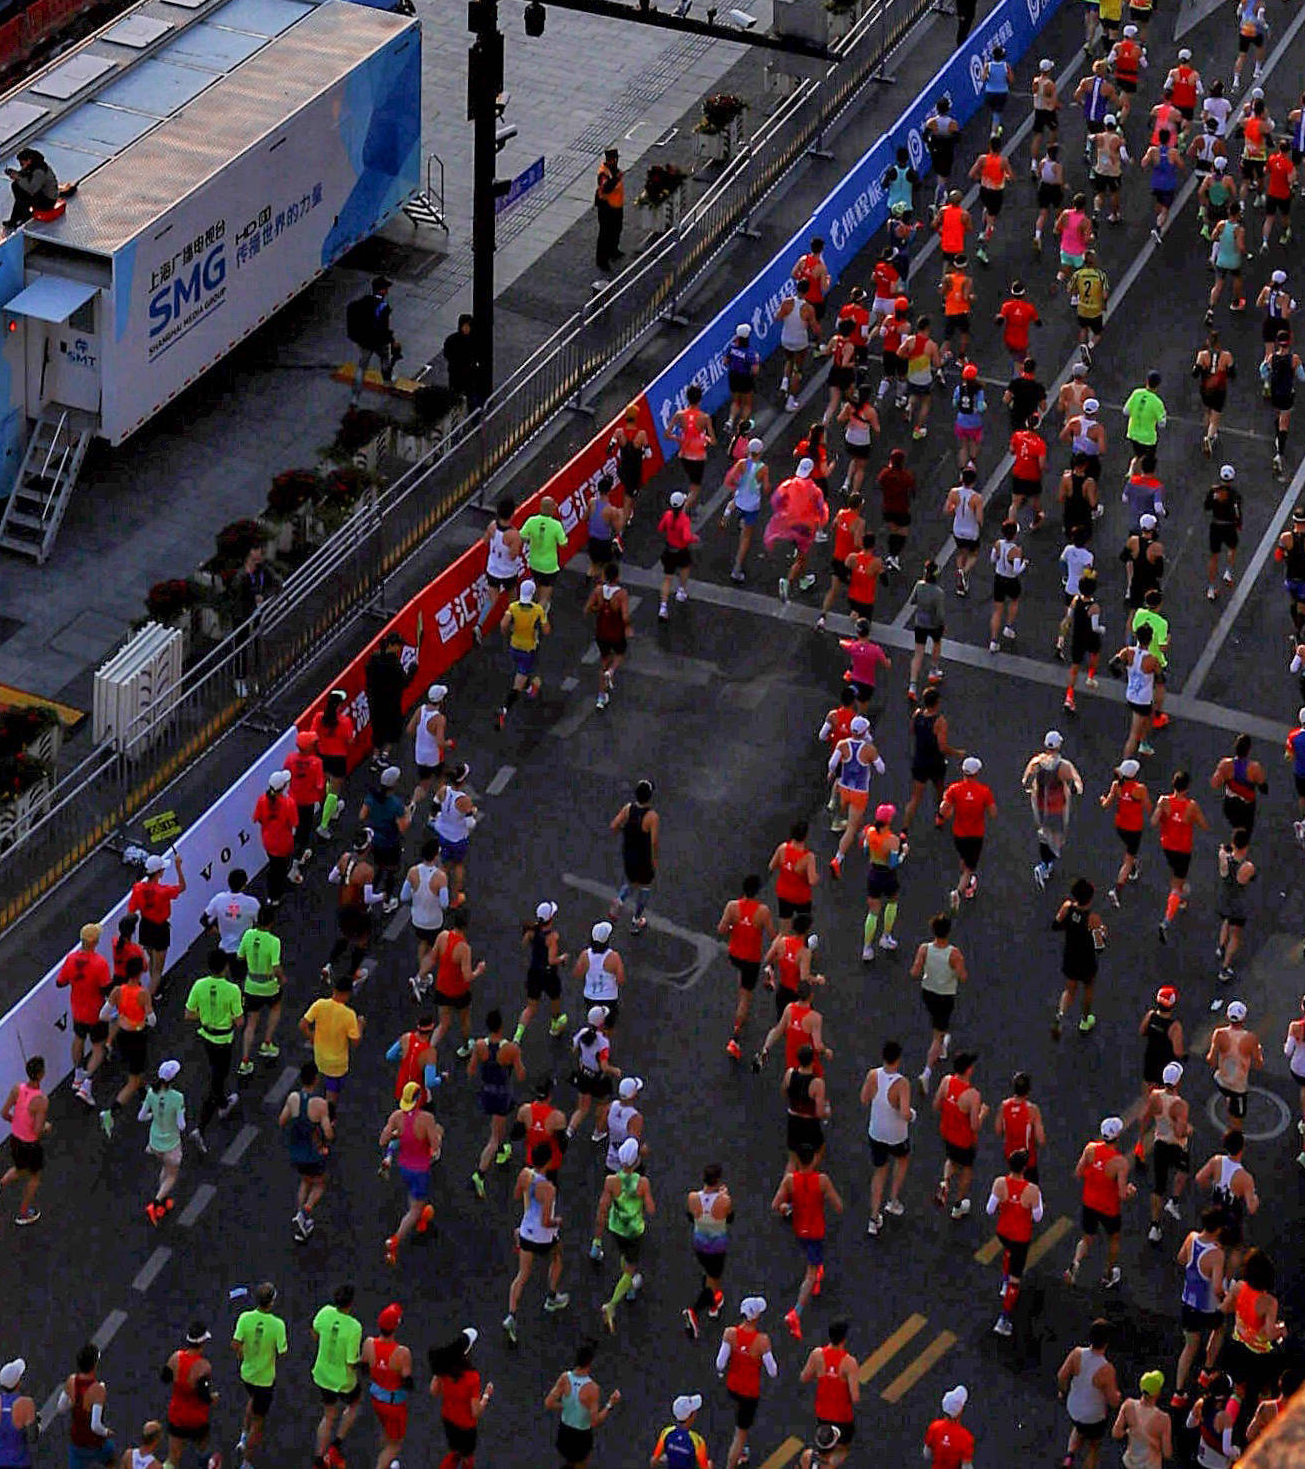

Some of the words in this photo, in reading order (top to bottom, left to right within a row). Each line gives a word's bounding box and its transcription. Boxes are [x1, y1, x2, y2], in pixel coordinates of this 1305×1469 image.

[149, 220, 226, 293] 上海广播电视台
[236, 182, 322, 269] 传播世界的力量
[149, 243, 226, 338] SMG
[183, 305, 203, 327] MEDIA
[200, 829, 250, 882] VOL
